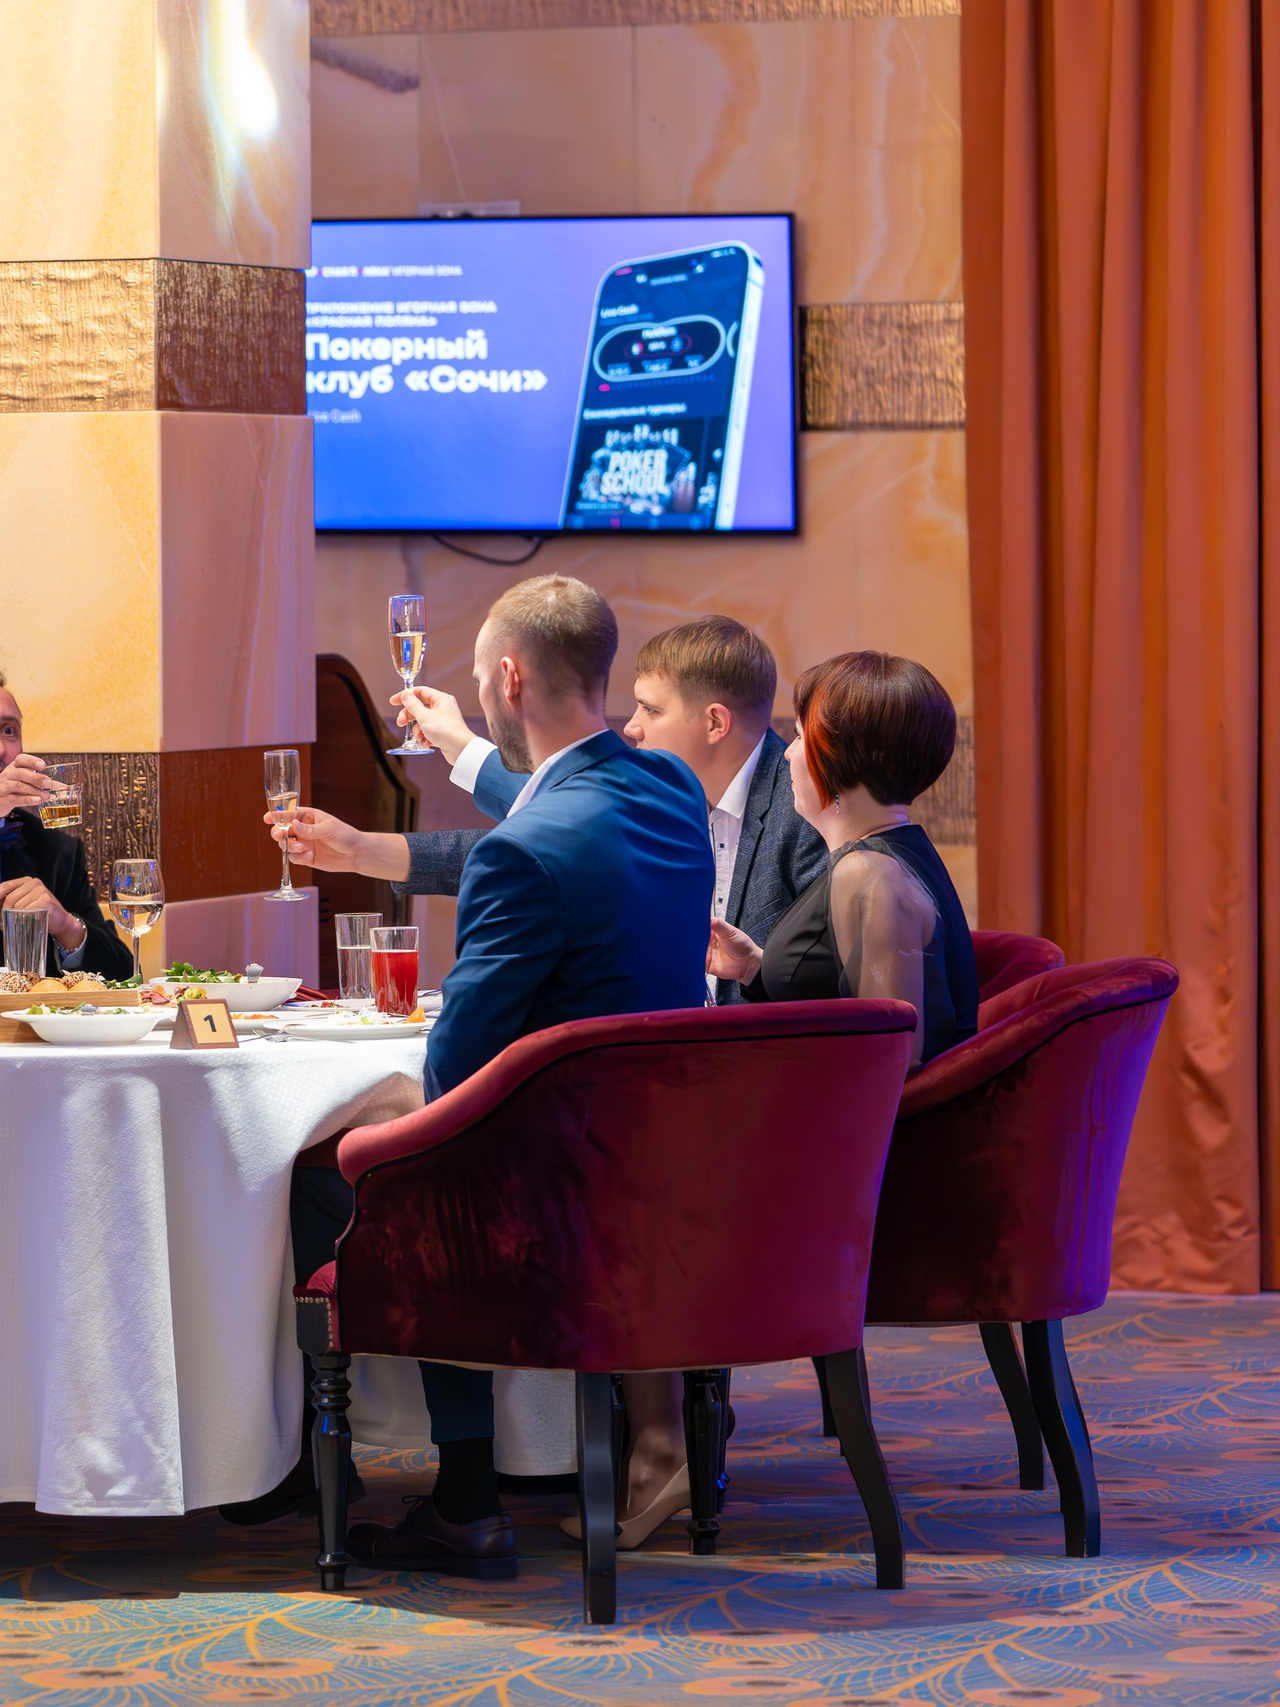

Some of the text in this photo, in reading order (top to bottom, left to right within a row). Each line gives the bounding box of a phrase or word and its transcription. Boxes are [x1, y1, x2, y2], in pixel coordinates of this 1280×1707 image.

[396, 301, 457, 314] ИГОРНАЯ
[459, 301, 498, 313] ЗОНА
[306, 328, 488, 366] Покерный
[306, 364, 549, 399] клуб «Сочи»
[608, 449, 668, 473] POKER
[600, 471, 669, 496] SCHOOL
[203, 1015, 217, 1032] 1
